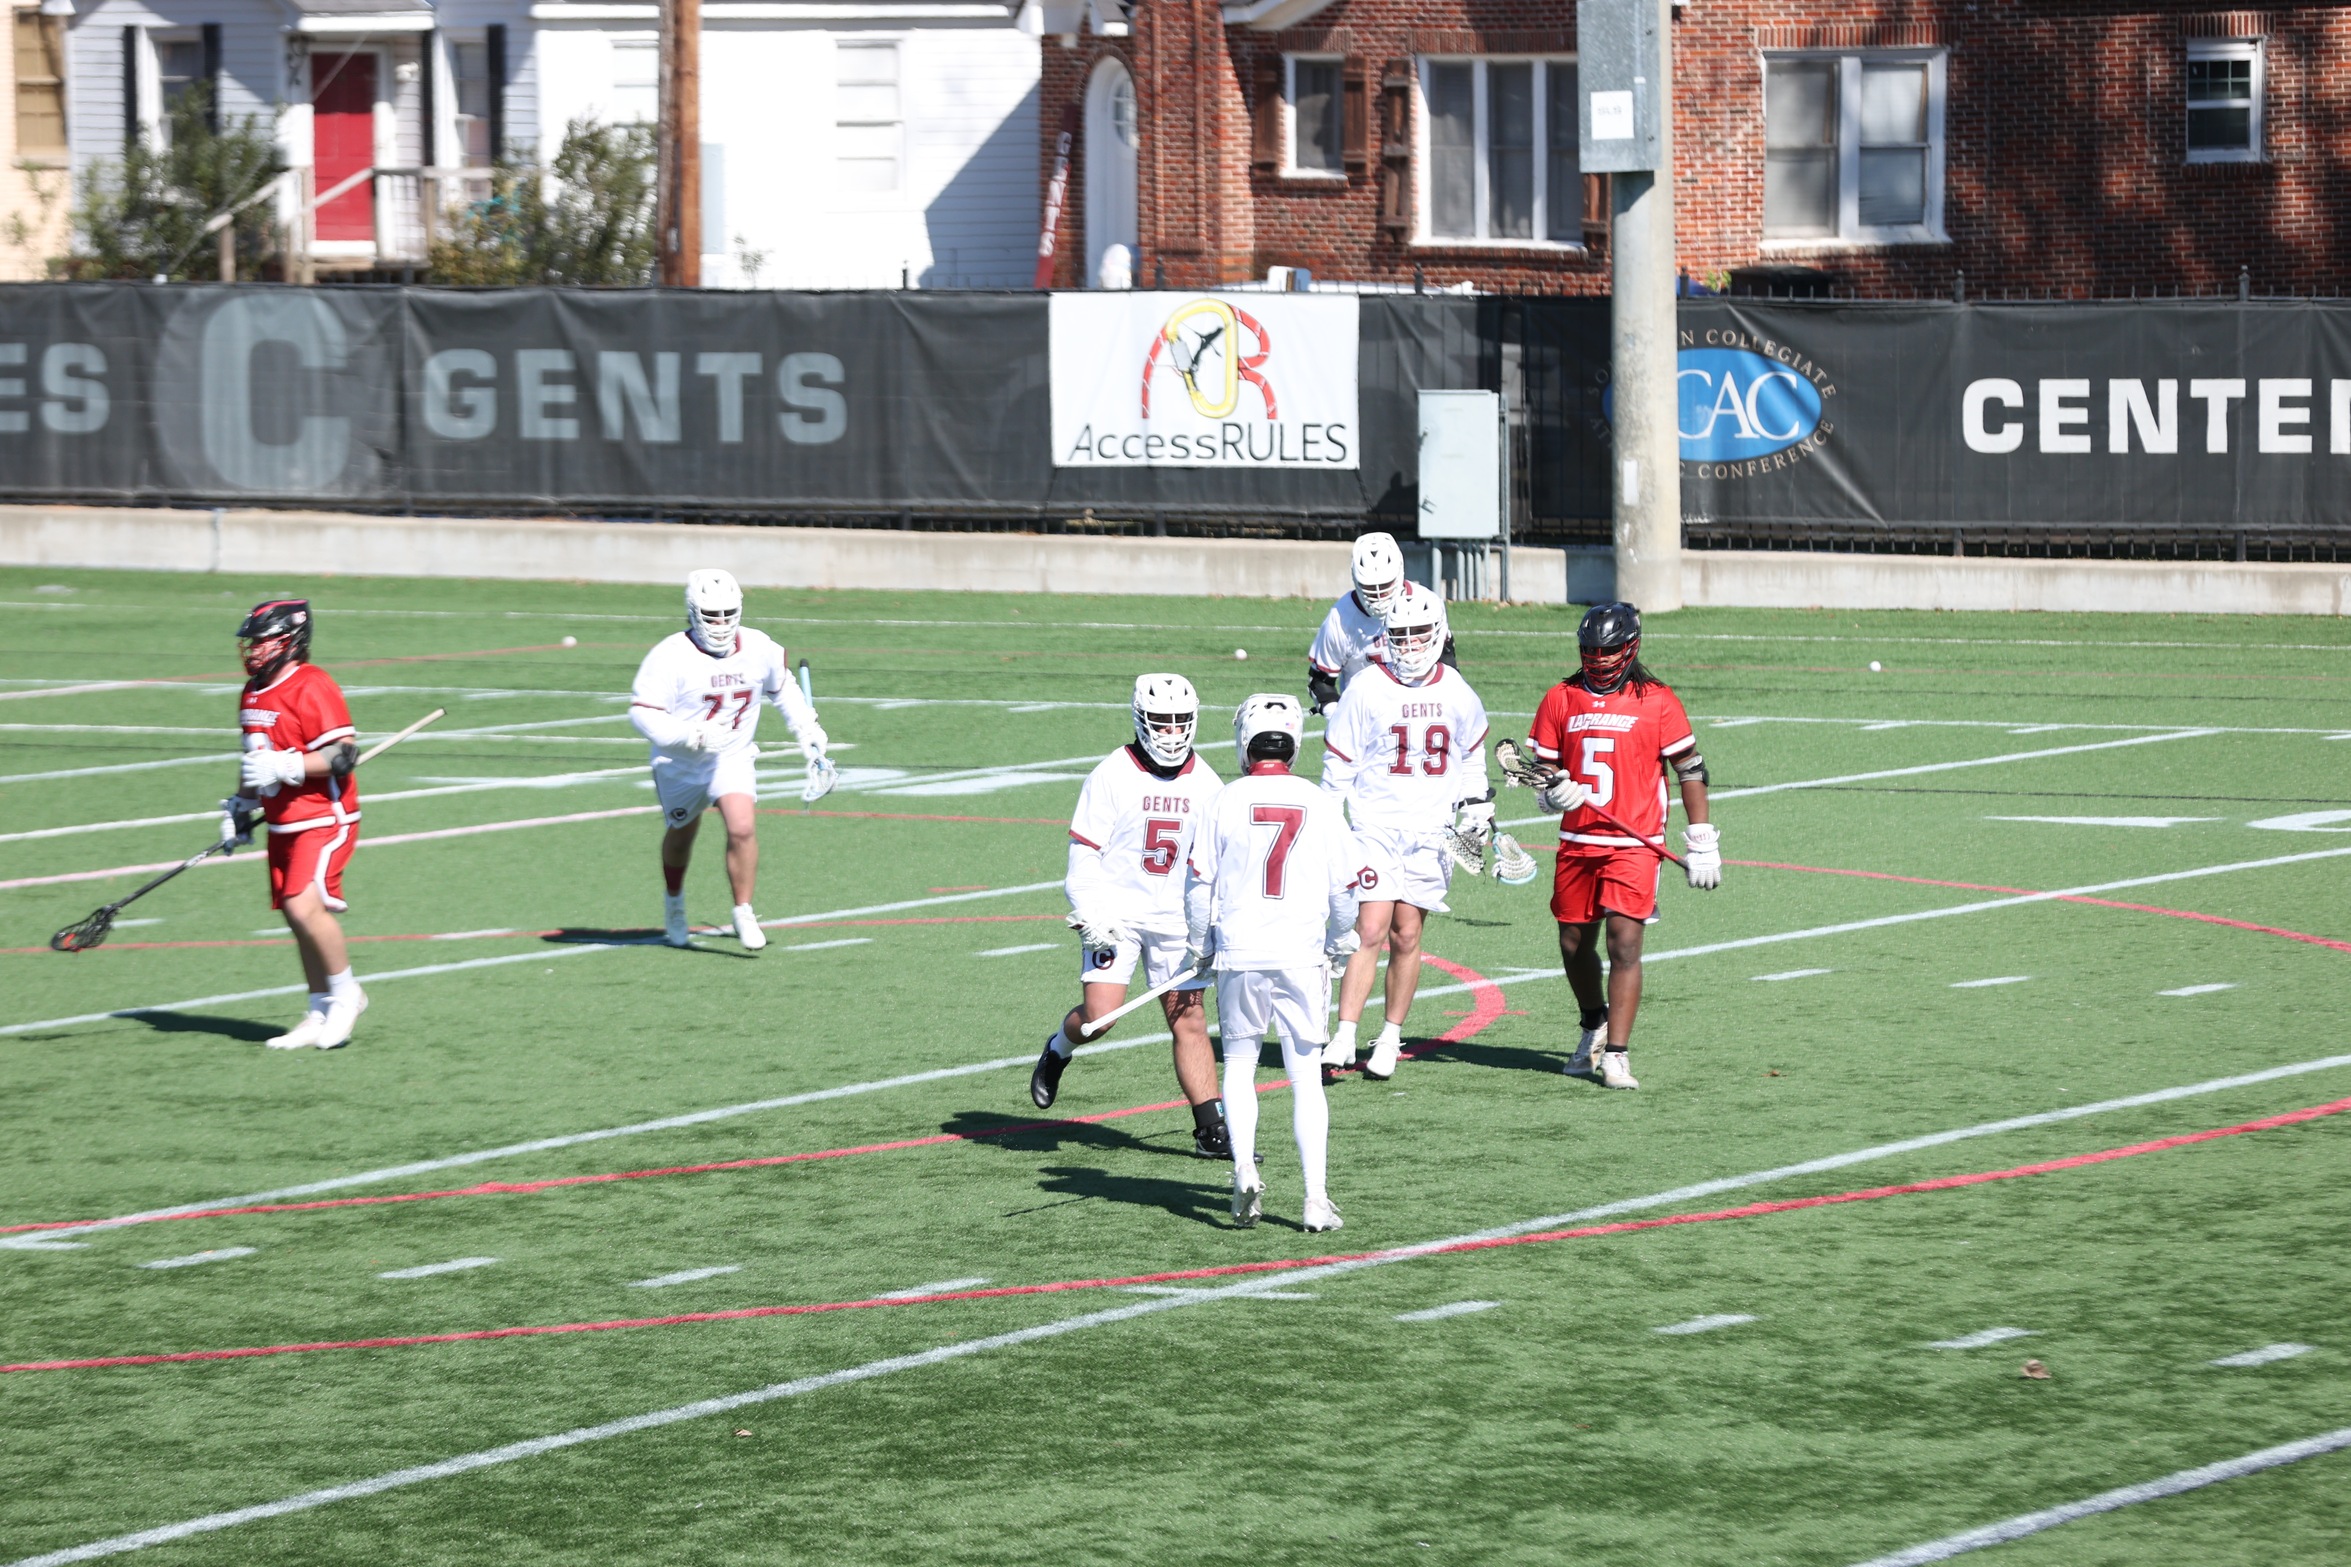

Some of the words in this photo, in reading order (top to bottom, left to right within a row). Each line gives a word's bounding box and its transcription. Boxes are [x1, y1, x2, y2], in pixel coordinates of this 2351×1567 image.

[204, 294, 351, 489] C
[1706, 329, 1837, 399] COLLEGIATE
[422, 348, 848, 443] GENTS
[1068, 423, 1347, 462] AccessRULES
[1698, 418, 1835, 480] CONFERENCE
[710, 673, 746, 688] GENTS
[1402, 703, 1443, 718] GENTS
[1568, 713, 1639, 732] LAGRANGE
[1388, 723, 1452, 777] 19
[1581, 736, 1616, 807] 5
[1143, 795, 1190, 813] GENTS
[1141, 816, 1183, 877] 5
[1250, 803, 1308, 901] 7
[1360, 868, 1378, 890] C
